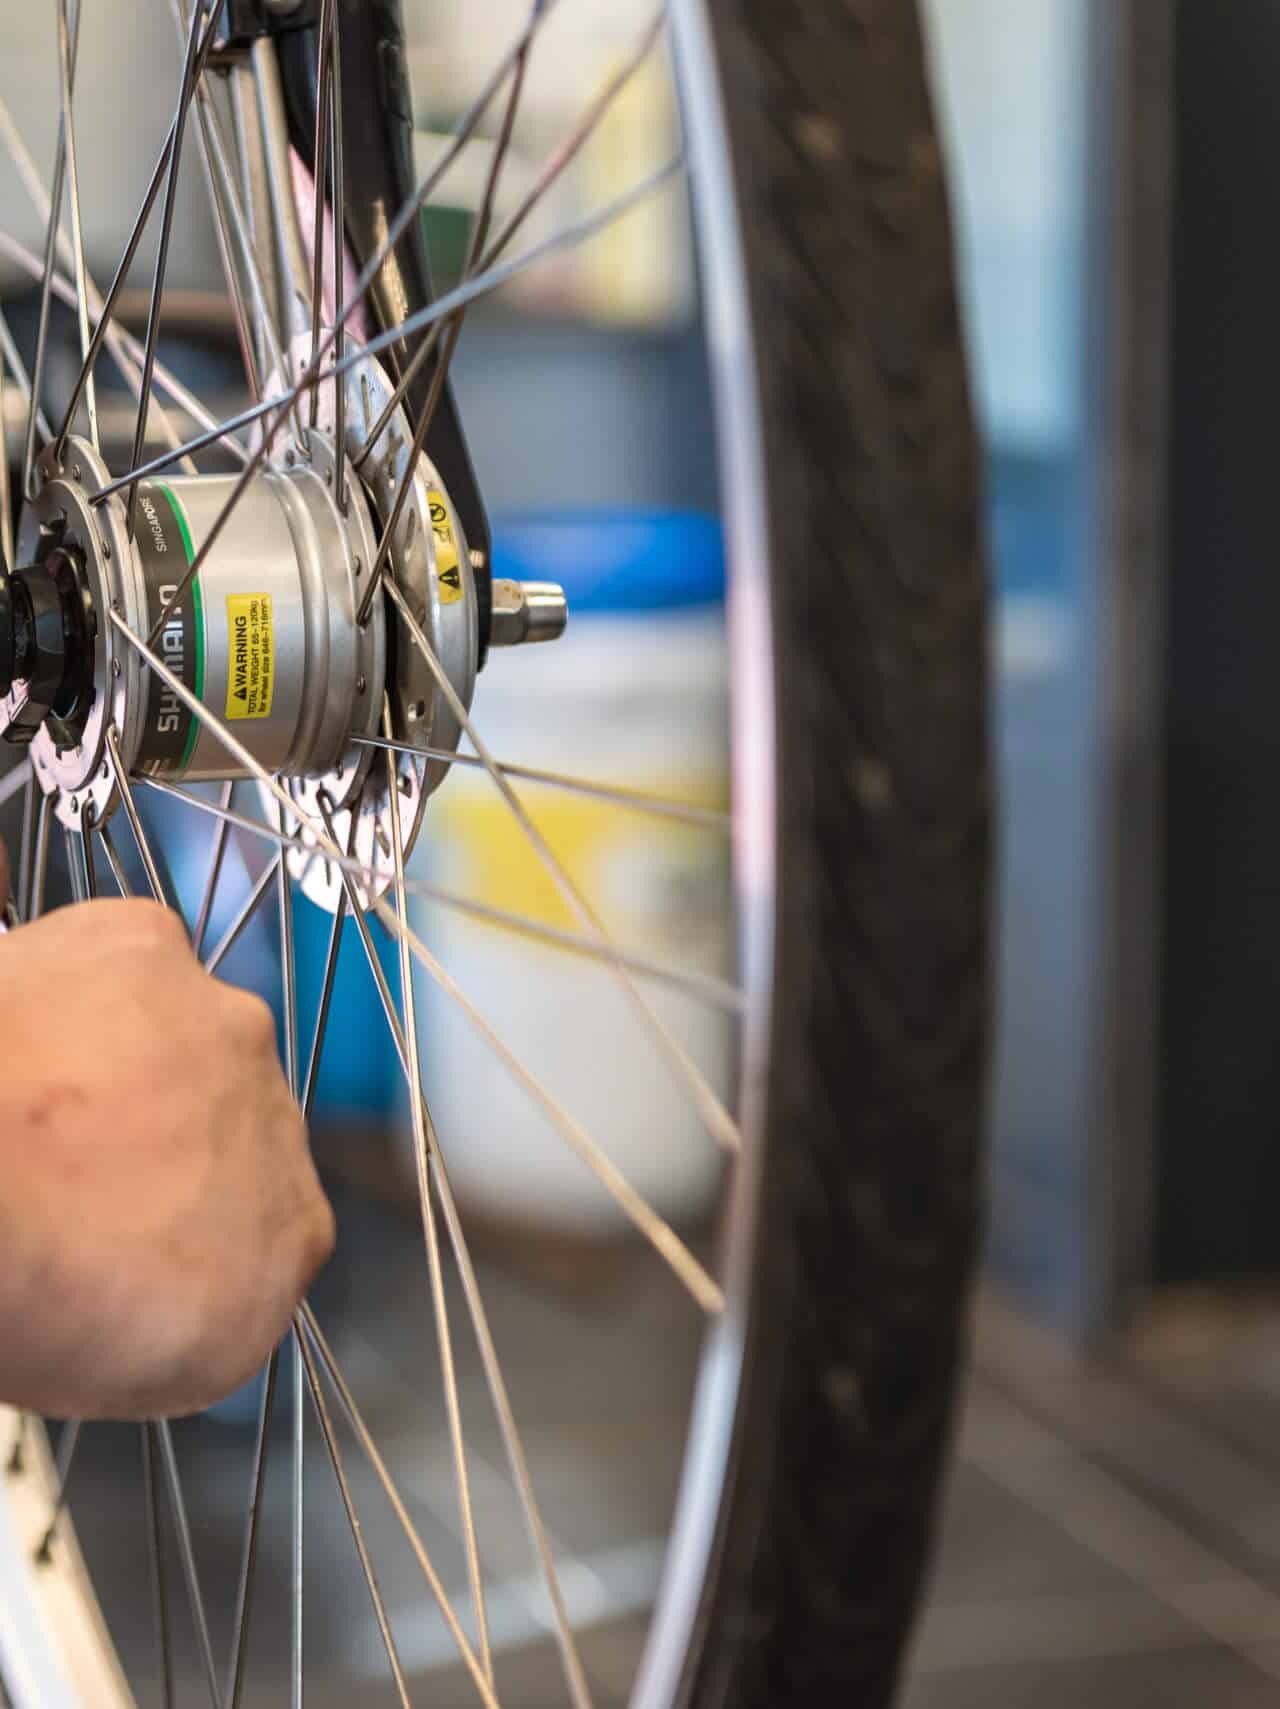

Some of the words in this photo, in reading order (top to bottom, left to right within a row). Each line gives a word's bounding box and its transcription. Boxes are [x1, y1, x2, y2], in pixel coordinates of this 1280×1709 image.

[140, 496, 168, 552] SINGAPORE
[235, 615, 247, 687] WARNING
[251, 648, 260, 687] WEIGHT
[248, 687, 258, 714] TOTAL
